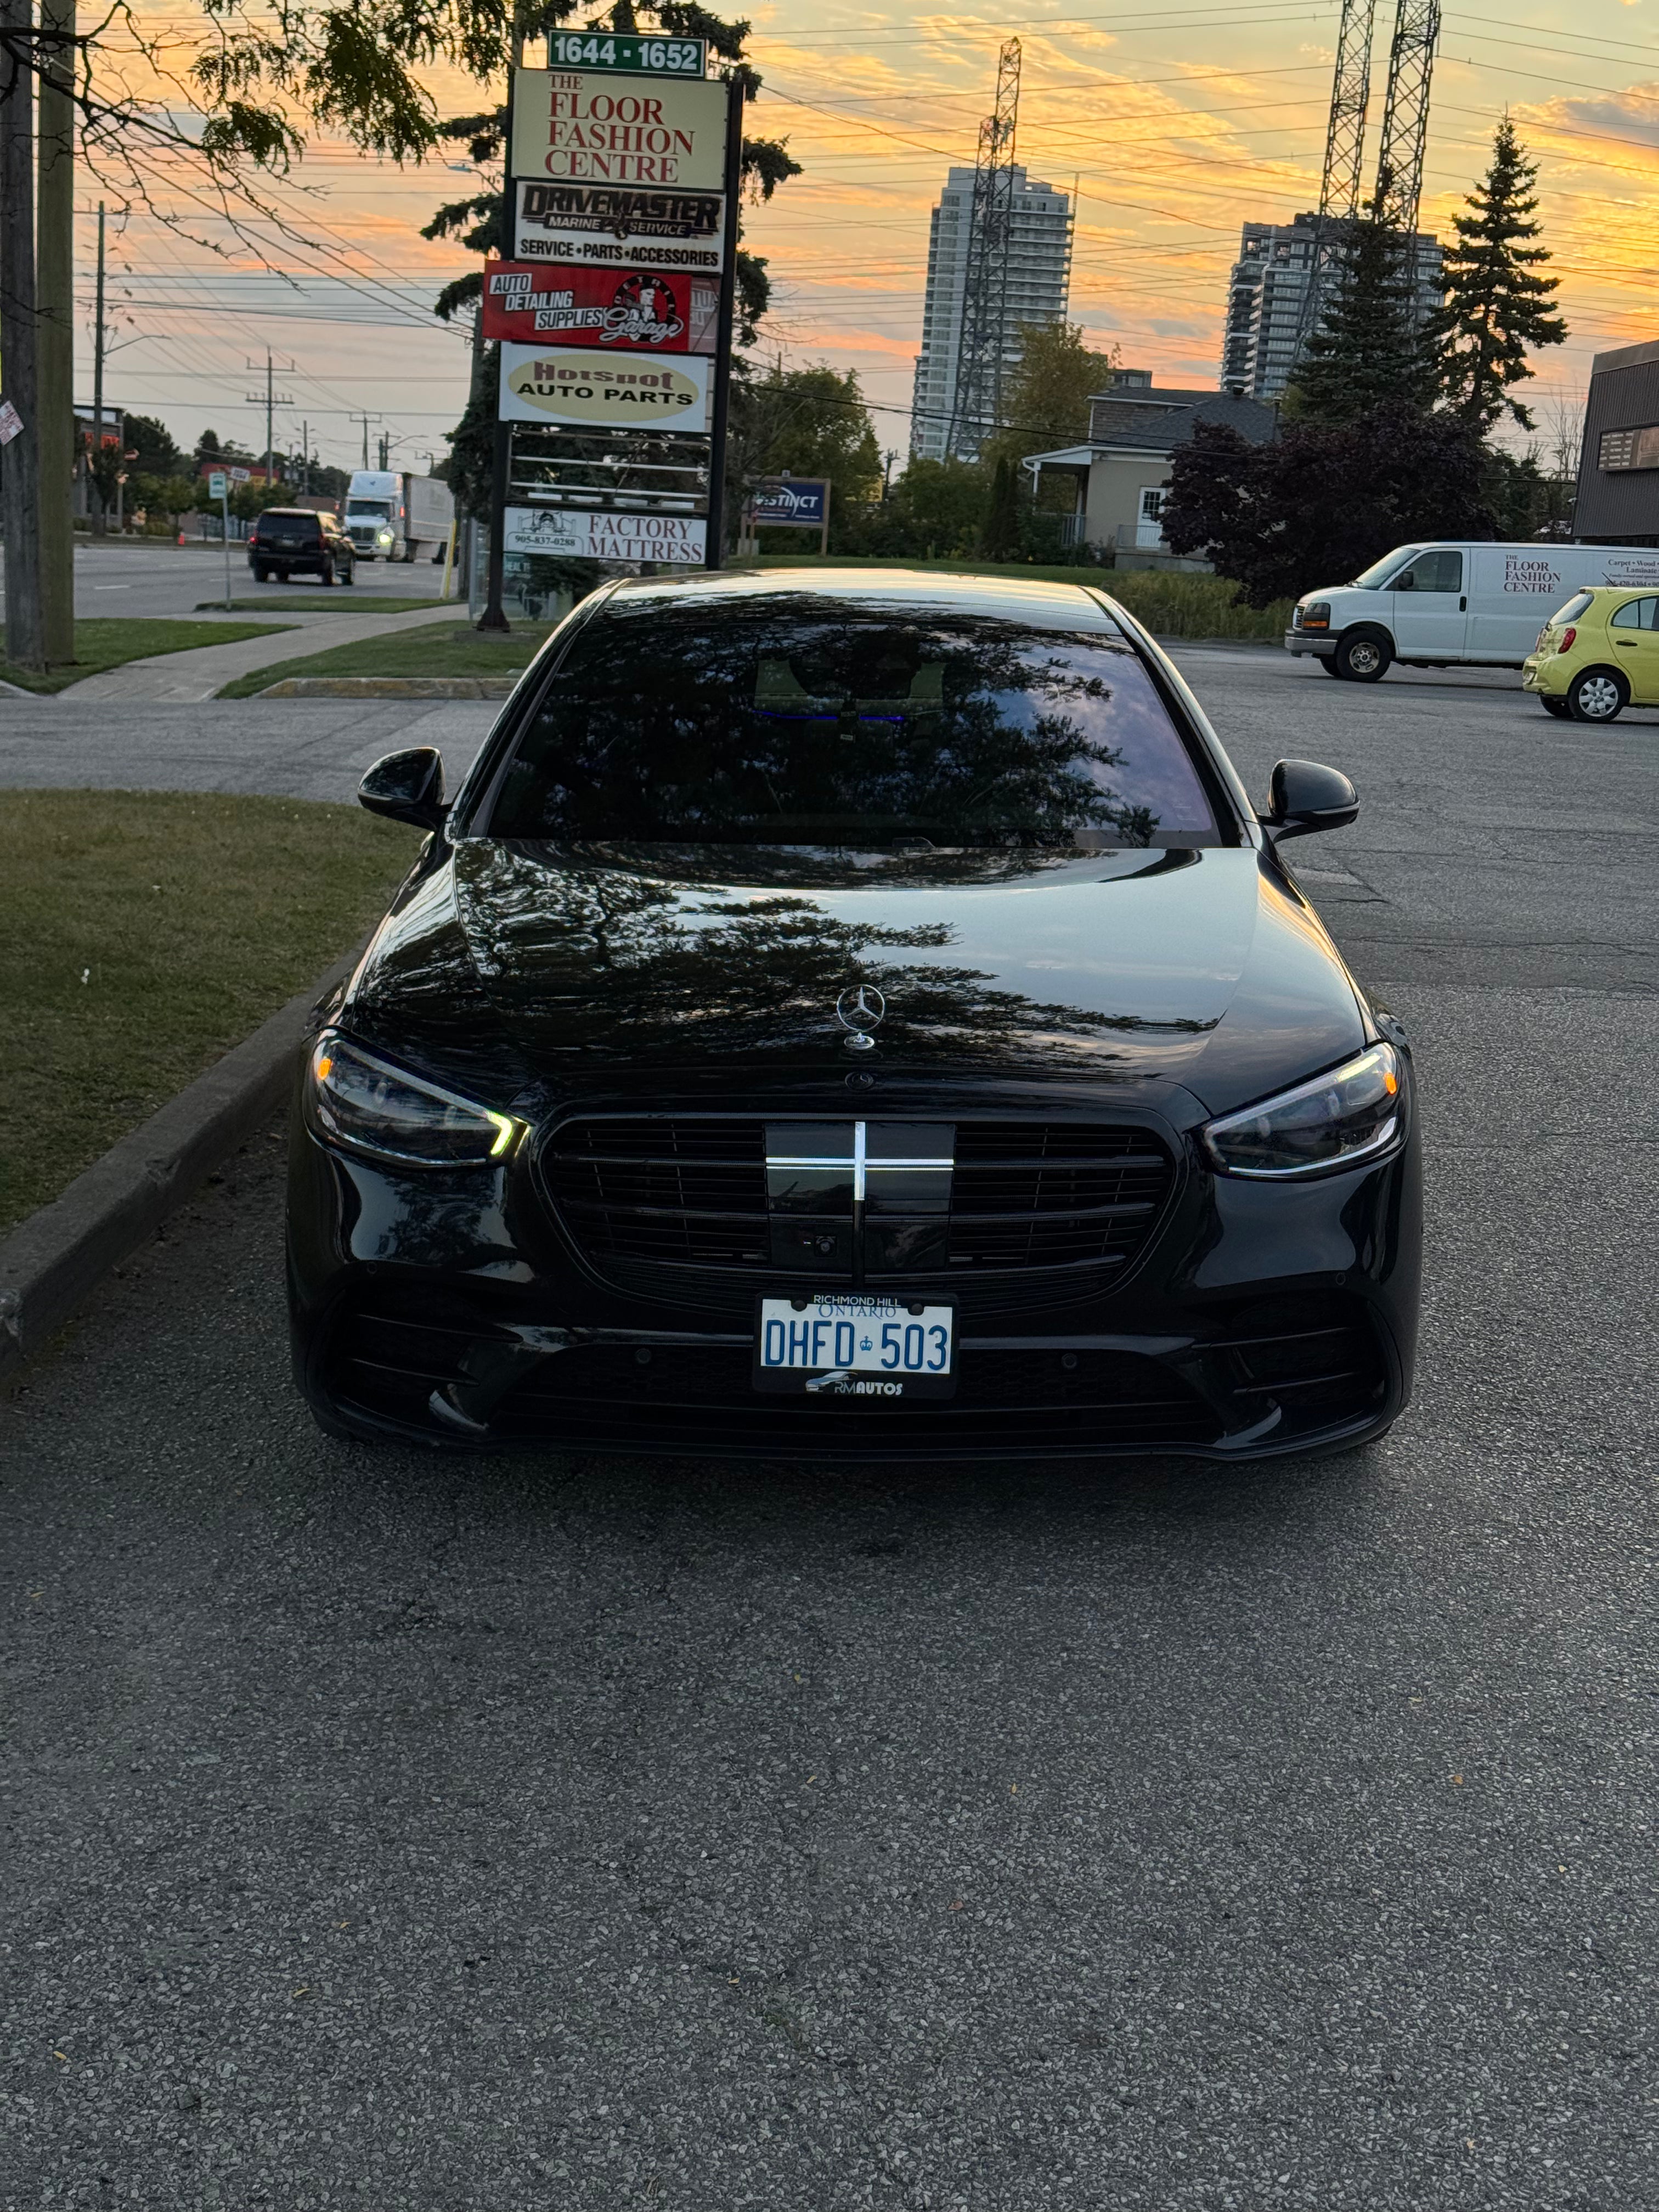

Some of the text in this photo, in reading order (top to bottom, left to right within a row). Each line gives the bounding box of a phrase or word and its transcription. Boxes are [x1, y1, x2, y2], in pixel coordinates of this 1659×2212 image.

[555, 37, 616, 65] 1644
[638, 42, 697, 70] 1652
[548, 74, 583, 90] THE
[548, 91, 665, 125] FLOOR
[546, 120, 696, 156] FASHION
[545, 149, 679, 183] CENTRE
[522, 184, 722, 233] DRIVEMASTER
[549, 216, 686, 235] MARINE SERVICE
[521, 239, 719, 267] SERVICE PARTS ACCESSORIES
[494, 275, 529, 292] AUTO
[505, 291, 574, 311] DETAILING
[538, 309, 602, 329] SUPPLIES
[599, 307, 684, 344] Garage
[517, 383, 693, 405] AUTO PARTS
[588, 515, 692, 539] FACTORY
[587, 536, 703, 562] MATTRESS
[1505, 561, 1549, 572] FLOOR
[1608, 558, 1631, 567] Carpet
[1505, 571, 1561, 582] FASHION
[1504, 582, 1555, 593] CENTRE
[813, 1295, 901, 1307] RICHMOND HILL
[818, 1304, 896, 1319] ONTARIO
[765, 1319, 947, 1370] DHFD 503
